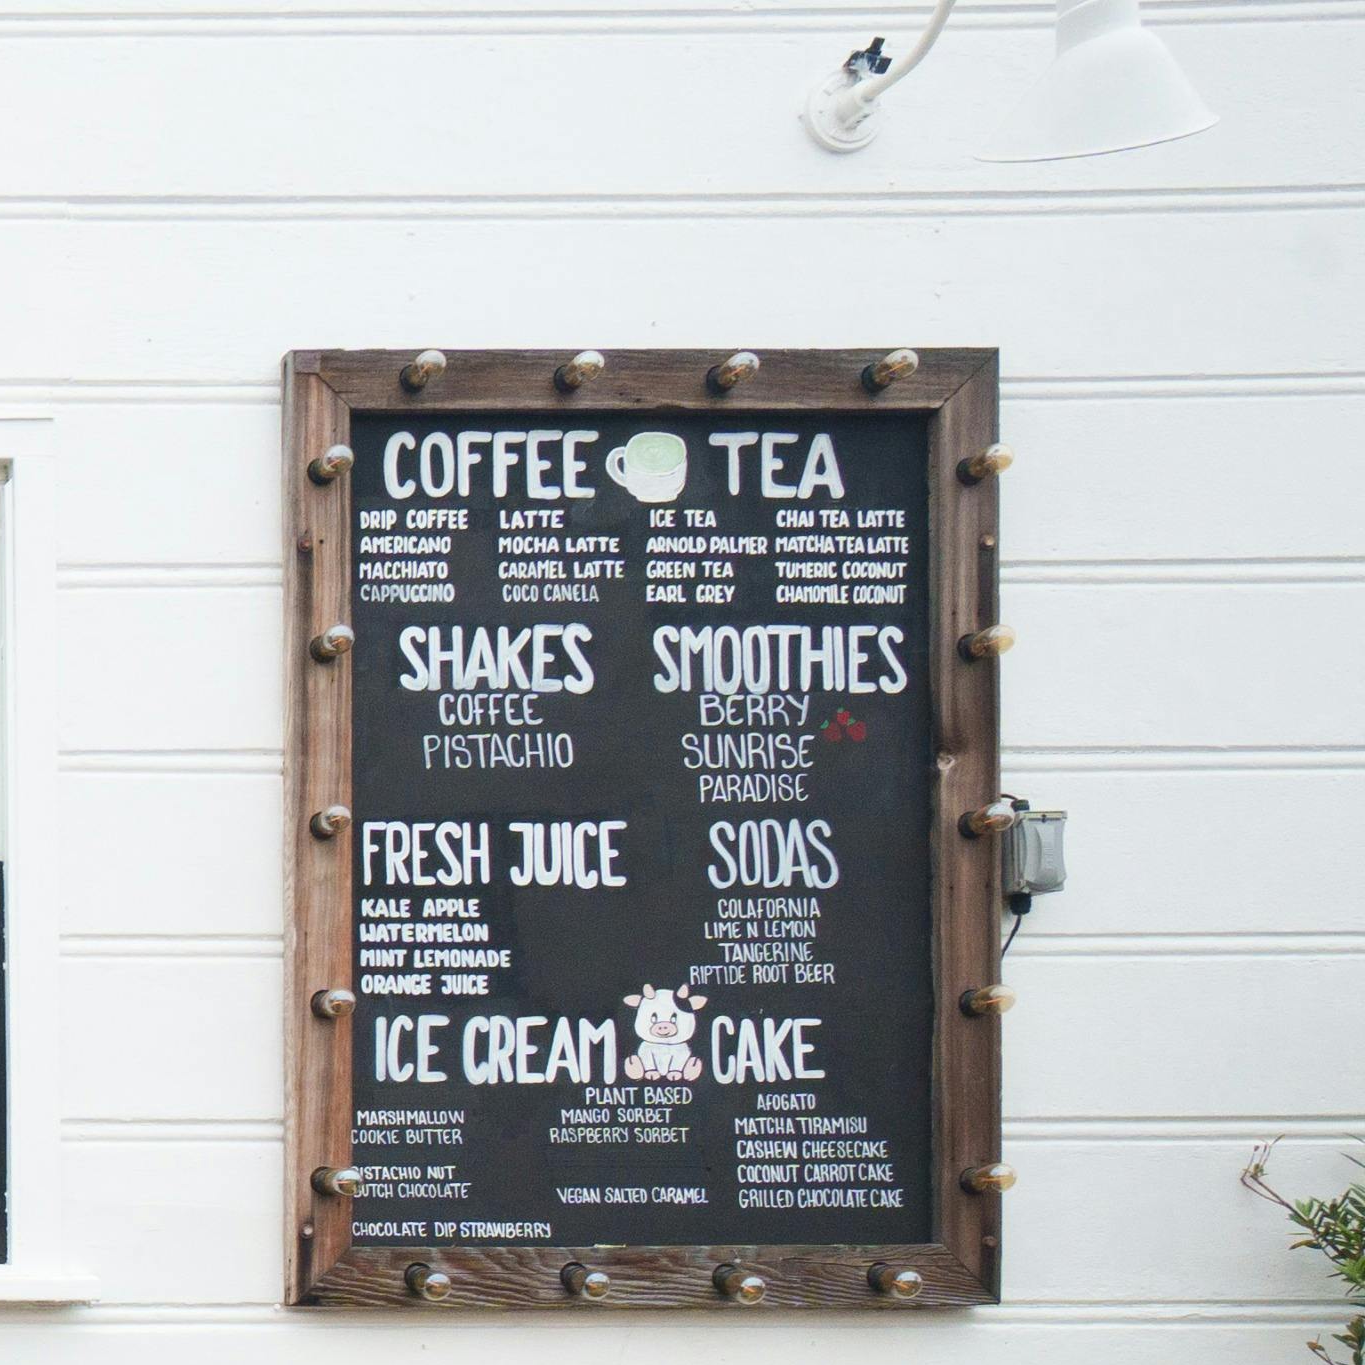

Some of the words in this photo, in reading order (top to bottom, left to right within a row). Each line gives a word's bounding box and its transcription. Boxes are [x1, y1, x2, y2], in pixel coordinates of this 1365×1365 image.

[384, 430, 599, 500] COFFEE
[709, 432, 844, 499] TEA
[360, 510, 397, 530] DRIP
[407, 509, 468, 529] COFFEE
[500, 510, 564, 529] LATTE
[650, 509, 675, 527] ICE
[684, 510, 716, 527] TEA
[819, 510, 849, 528] TEA
[858, 510, 904, 528] LATTE
[361, 536, 451, 554] AMERICANO
[499, 536, 559, 554] MOCHA
[566, 537, 619, 553] LATTE
[646, 536, 707, 553] ARNOLD
[710, 536, 767, 554] PALMER
[776, 535, 835, 553] MATCHA
[835, 536, 863, 554] TEA
[868, 537, 908, 554] LATTE
[360, 561, 448, 579] MACCHIATO
[499, 560, 566, 579] CARAMEL
[574, 560, 624, 578] LATTE
[647, 560, 695, 578] GREEN
[702, 561, 733, 578] TEA
[775, 562, 837, 578] TUMERIC
[843, 561, 907, 579] COCONUT
[361, 584, 455, 603] CAPPUCCINO
[503, 584, 538, 602] COCO
[544, 584, 599, 602] CANELA
[647, 585, 686, 602] EARL
[696, 584, 735, 603] GREY
[776, 584, 849, 604] CHAMOMILE
[853, 585, 906, 604] COCONUT
[400, 623, 594, 694] SHAKES
[653, 625, 907, 697] SMOOTHIES
[439, 694, 543, 725] COFFEE
[700, 694, 809, 726] BERRY
[424, 733, 573, 769] PISTACHIO
[682, 733, 814, 769] SUNRISE
[700, 774, 808, 803] PARADISE
[363, 822, 490, 886] FRESH
[509, 821, 627, 889] JUICE
[708, 819, 838, 889] SODAS
[362, 899, 410, 918] KALE
[423, 899, 480, 917] APPLE
[718, 898, 821, 918] COLAFORNIA
[360, 923, 488, 943] WATERMELON
[705, 922, 741, 939] LIME
[747, 922, 758, 938] N
[765, 920, 816, 938] LEMON
[361, 949, 407, 967] MINT
[414, 949, 510, 968] LEMONADE
[718, 942, 813, 963] TANGERINE
[690, 965, 746, 985] RIPTIDE
[753, 964, 789, 983] ROOT
[795, 964, 835, 984] BEER
[362, 974, 431, 995] ORANGE
[441, 975, 488, 995] JUICE
[376, 1015, 450, 1082] ICE
[463, 1015, 616, 1085] CREAM
[712, 1016, 825, 1084] CAKE
[586, 1087, 638, 1105] PLANT
[644, 1087, 692, 1104] BASED
[757, 1094, 815, 1110] AFOGATO
[357, 1111, 464, 1125] MARSHMALLOW
[561, 1108, 609, 1124] MANGO
[618, 1108, 672, 1123] SORBET
[550, 1127, 628, 1143] RASPBERRY
[634, 1127, 689, 1143] SORBET
[735, 1117, 795, 1135] MATCHA
[795, 1117, 867, 1134] TIRAMISU
[352, 1130, 399, 1144] COOKIE
[406, 1129, 462, 1144] BUTTER
[737, 1140, 797, 1159] CASHEW
[803, 1141, 887, 1159] CHEESECAKE
[352, 1166, 421, 1181] ISTACHIO
[428, 1166, 455, 1179] NUT
[738, 1165, 800, 1183] COCONUT
[805, 1164, 856, 1182] CARROT
[858, 1163, 893, 1182] CAKE
[398, 1183, 471, 1198] CHOCOLATE
[557, 1188, 600, 1203] VEGAN
[605, 1187, 647, 1203] SALTED
[652, 1187, 708, 1204] CARAMEL
[739, 1189, 794, 1208] GRILLED
[798, 1189, 868, 1208] CHOCOLATE
[870, 1189, 903, 1208] CAKE
[352, 1222, 427, 1236] CHOCOLATE
[434, 1222, 456, 1237] DIP
[460, 1222, 551, 1238] STRAWBERRY
